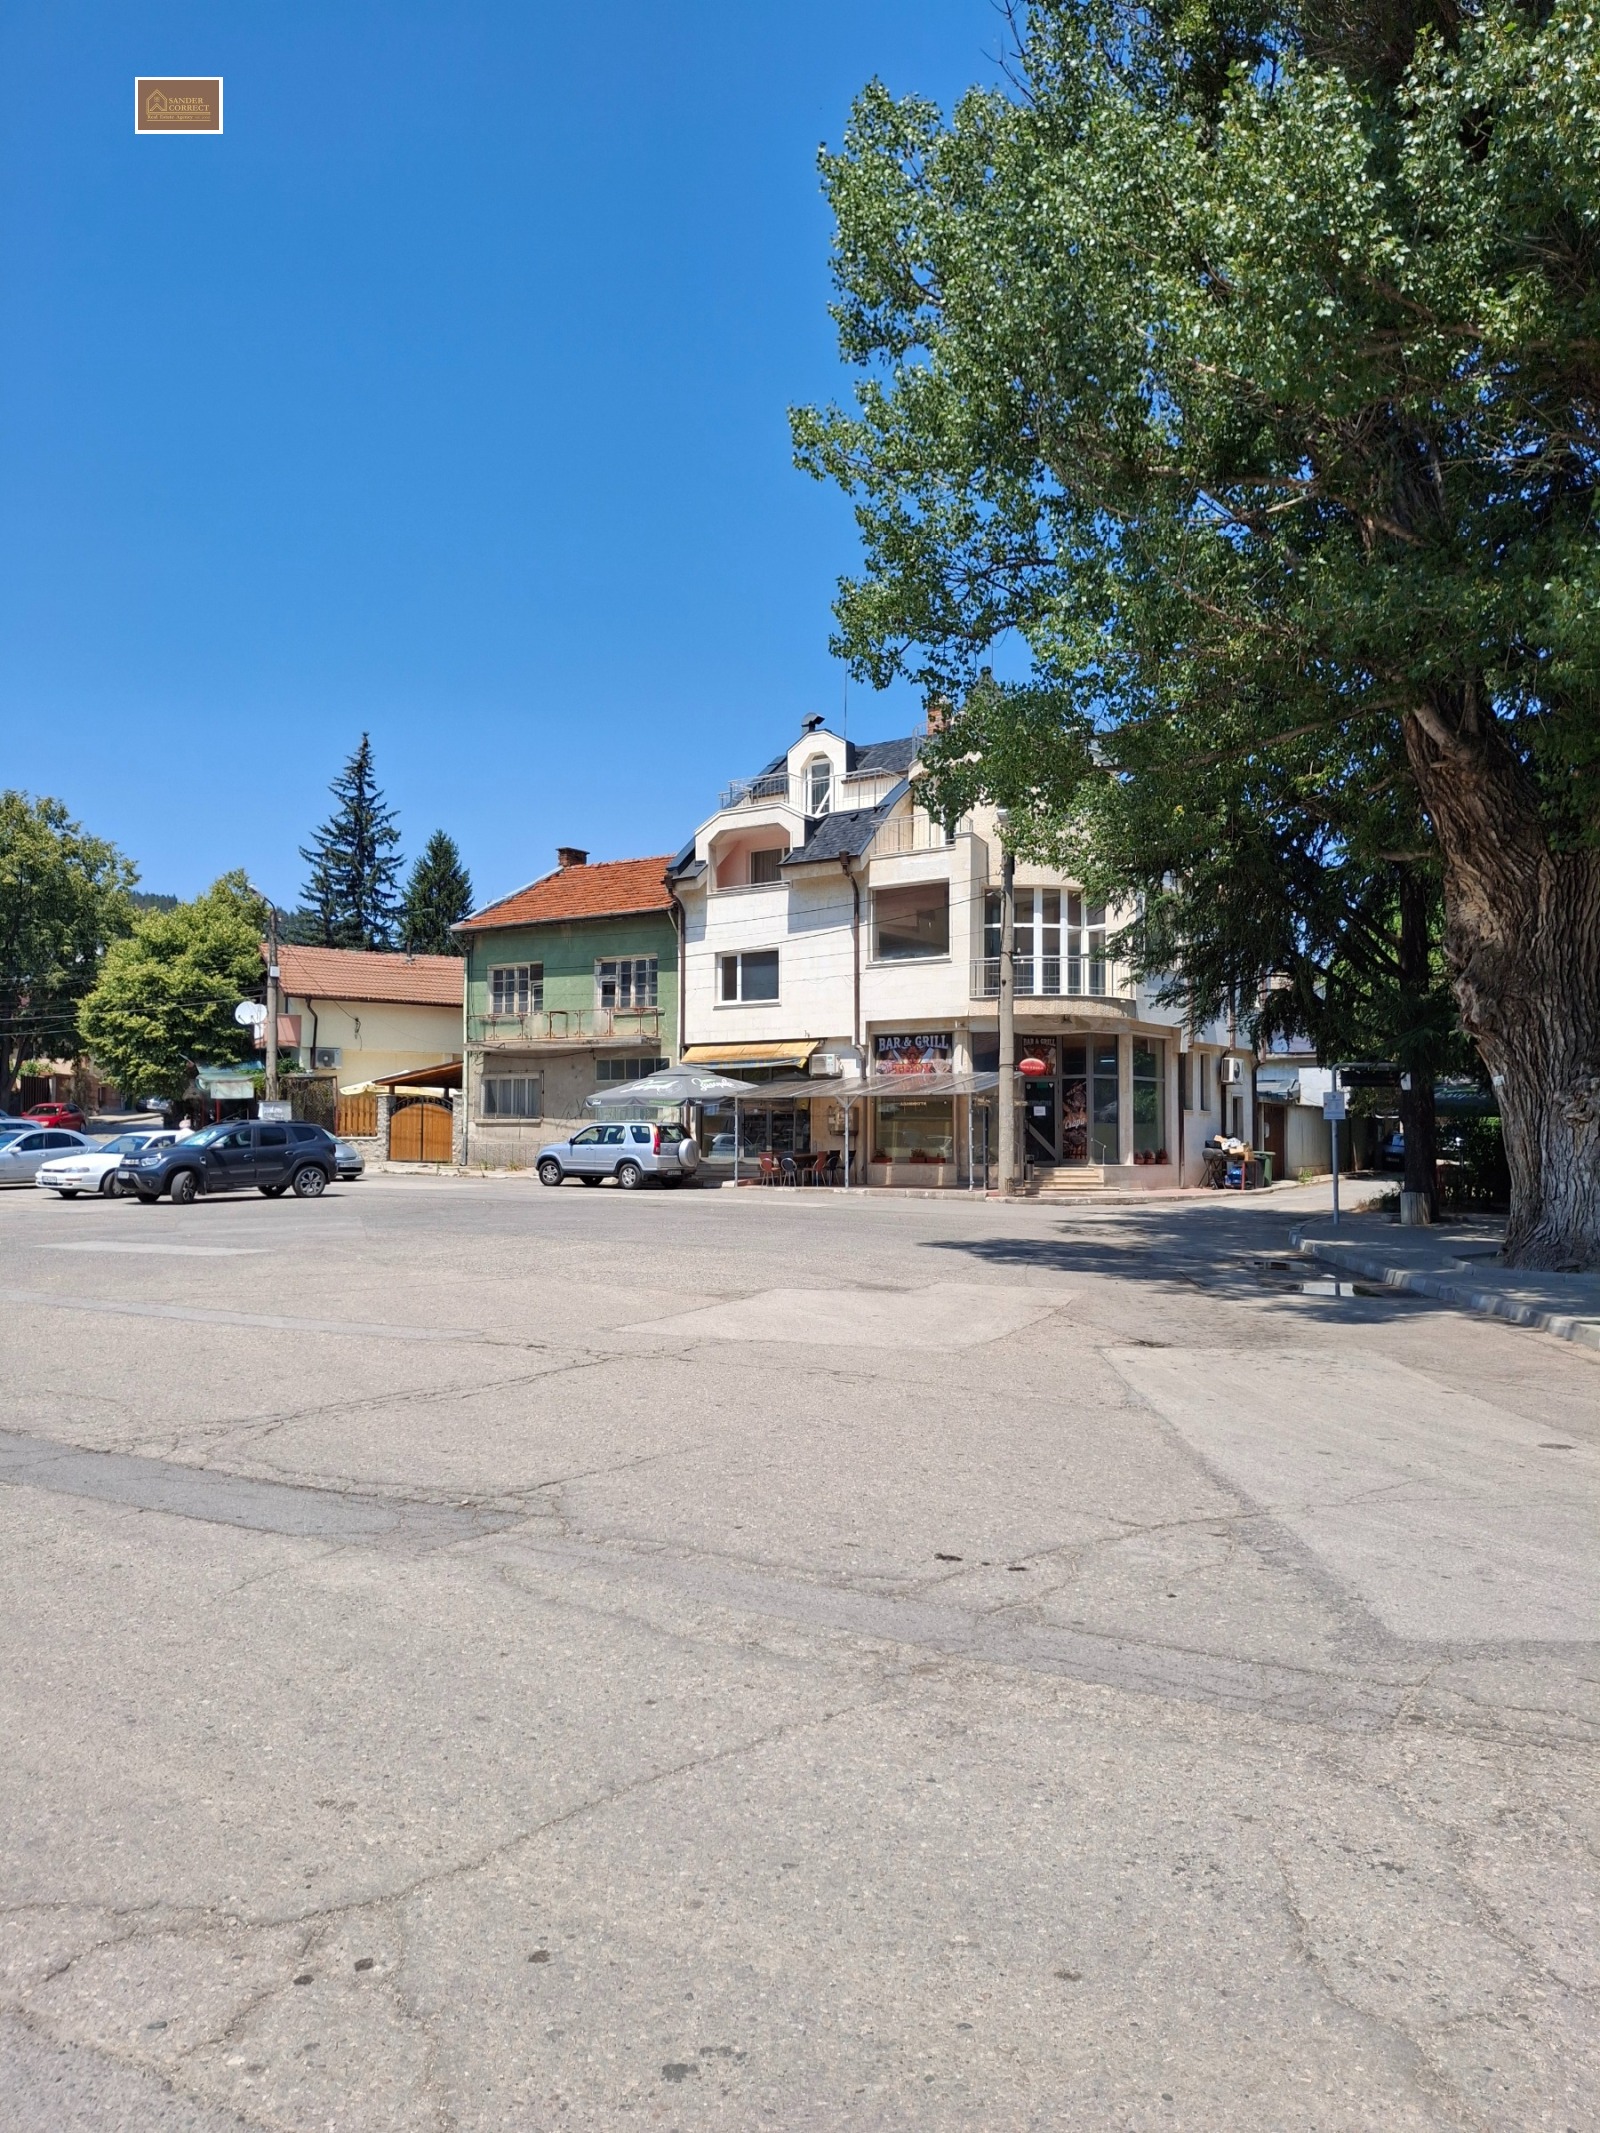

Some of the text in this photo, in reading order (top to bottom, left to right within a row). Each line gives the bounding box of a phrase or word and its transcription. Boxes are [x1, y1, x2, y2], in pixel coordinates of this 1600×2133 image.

[878, 1034, 949, 1052] BAR & GRILL
[1023, 1037, 1034, 1046] BAR
[1040, 1038, 1057, 1047] GRILL
